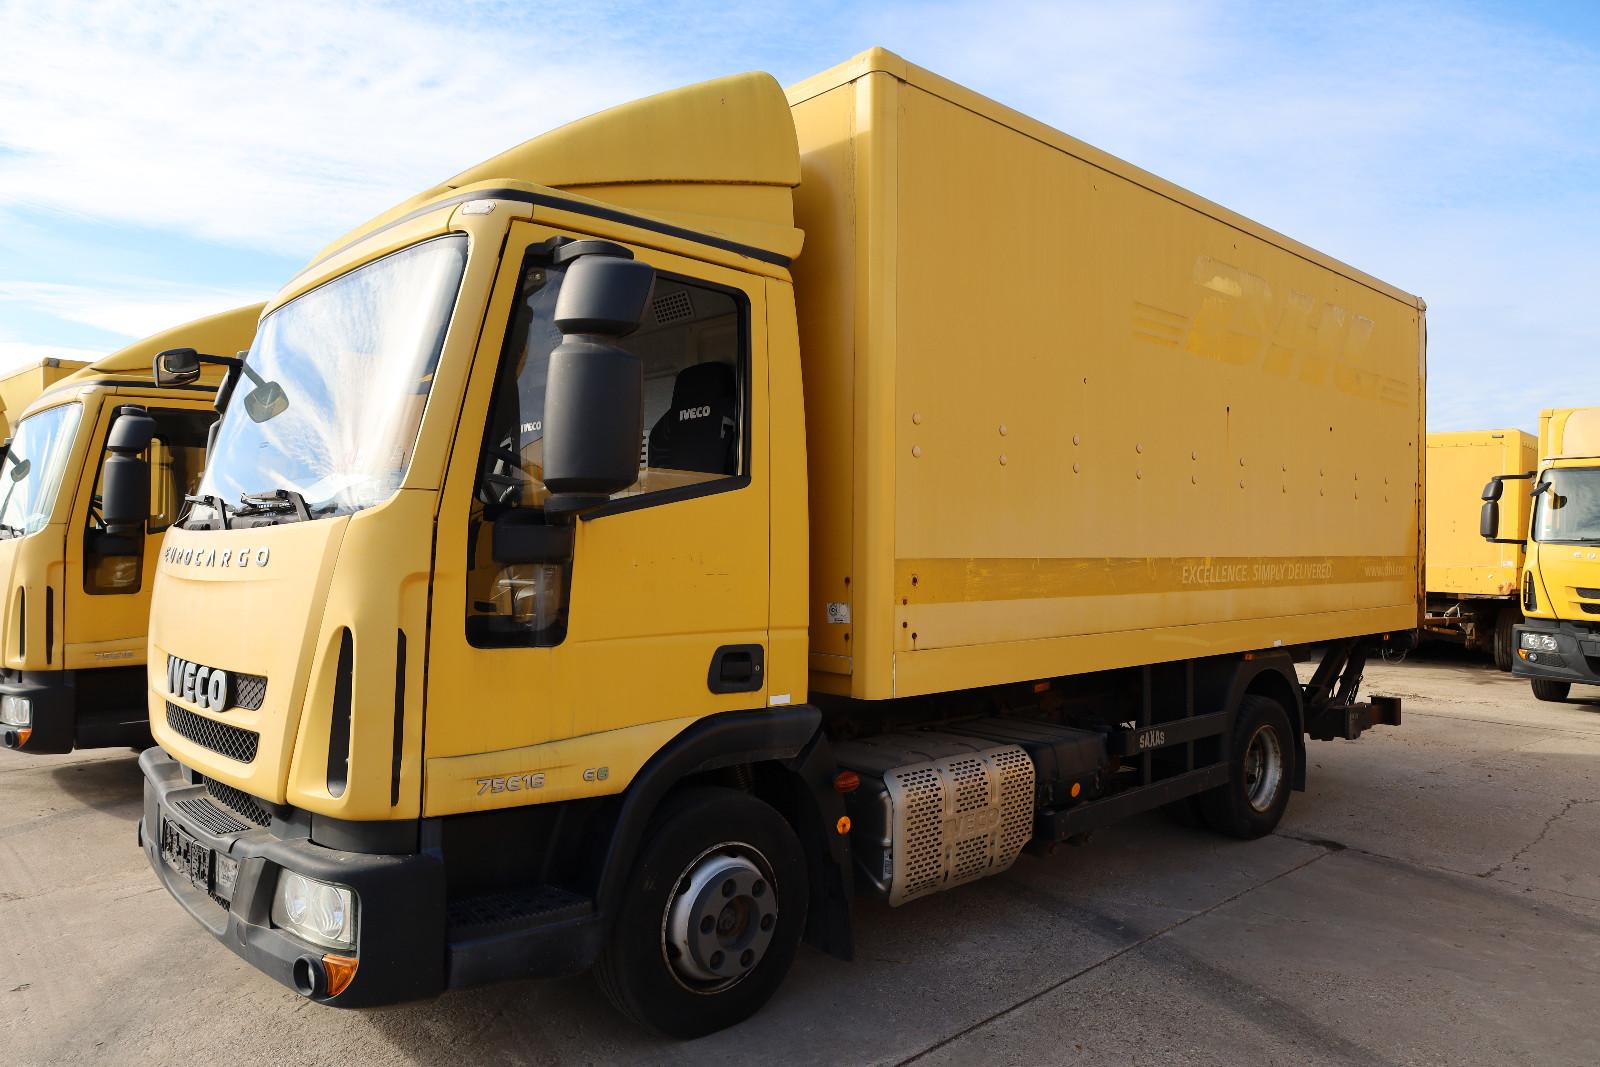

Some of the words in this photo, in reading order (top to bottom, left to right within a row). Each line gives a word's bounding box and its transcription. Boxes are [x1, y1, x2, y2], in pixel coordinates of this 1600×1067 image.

[678, 405, 711, 422] IVECO
[520, 420, 542, 433] IVECO
[165, 546, 270, 567] EUROCARGO
[1252, 563, 1287, 583] SIMPLY
[167, 655, 228, 712] IVECO
[1139, 730, 1165, 749] SAXAS
[476, 772, 545, 796] 75E16
